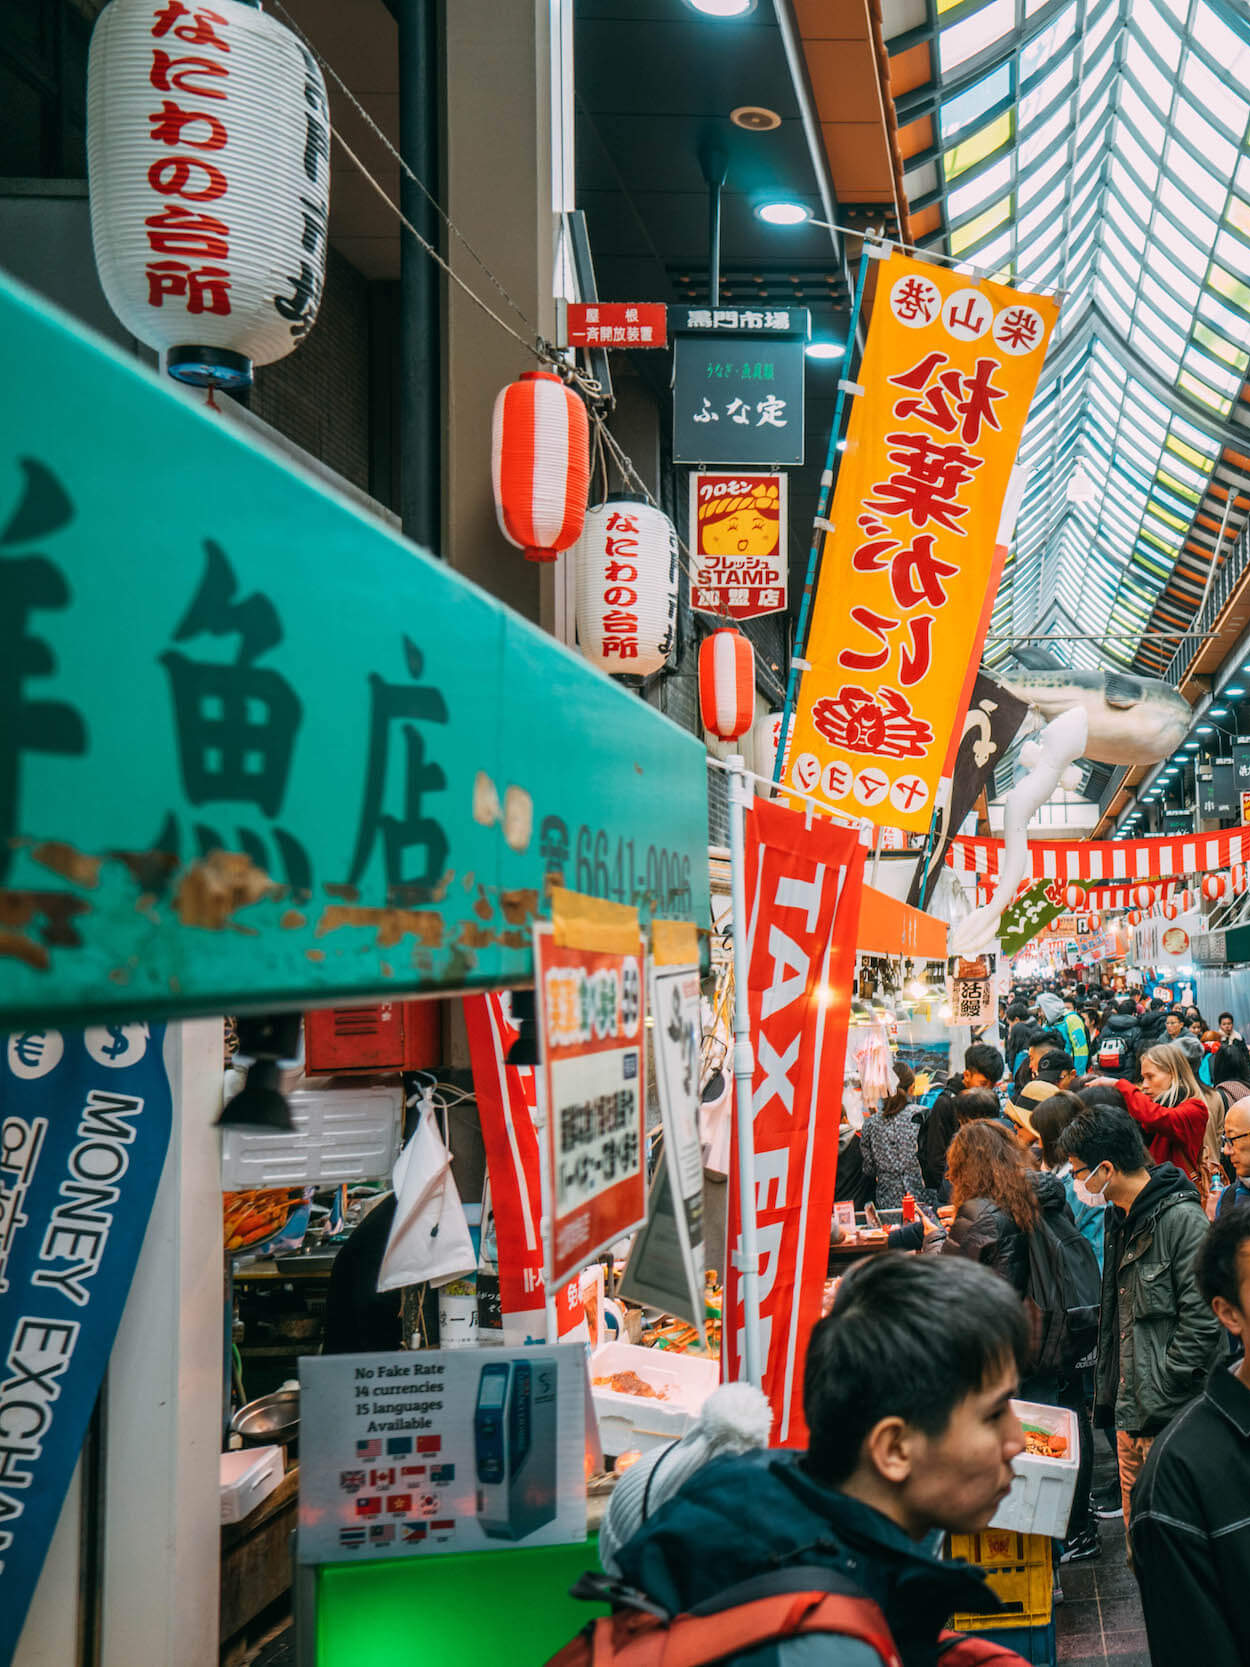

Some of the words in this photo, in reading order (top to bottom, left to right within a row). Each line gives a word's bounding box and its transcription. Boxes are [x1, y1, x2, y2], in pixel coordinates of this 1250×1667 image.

[145, 0, 233, 317] なにわの台所
[687, 310, 790, 330] 黒門市場
[693, 395, 788, 428] ふな定
[700, 480, 752, 500] クロモン
[703, 556, 770, 571] フレッシュ
[602, 511, 640, 660] なにわの台所
[697, 569, 780, 586] STAMP
[697, 588, 780, 607] 加盟店
[33, 1090, 143, 1306] MONEY
[355, 1367, 375, 1380] No
[377, 1365, 411, 1379] Fake
[414, 1363, 445, 1376] Rate
[355, 1386, 370, 1398] 14
[373, 1381, 445, 1396] currencies
[356, 1403, 370, 1416] 15
[372, 1399, 443, 1416] languages
[366, 1417, 432, 1433] Available
